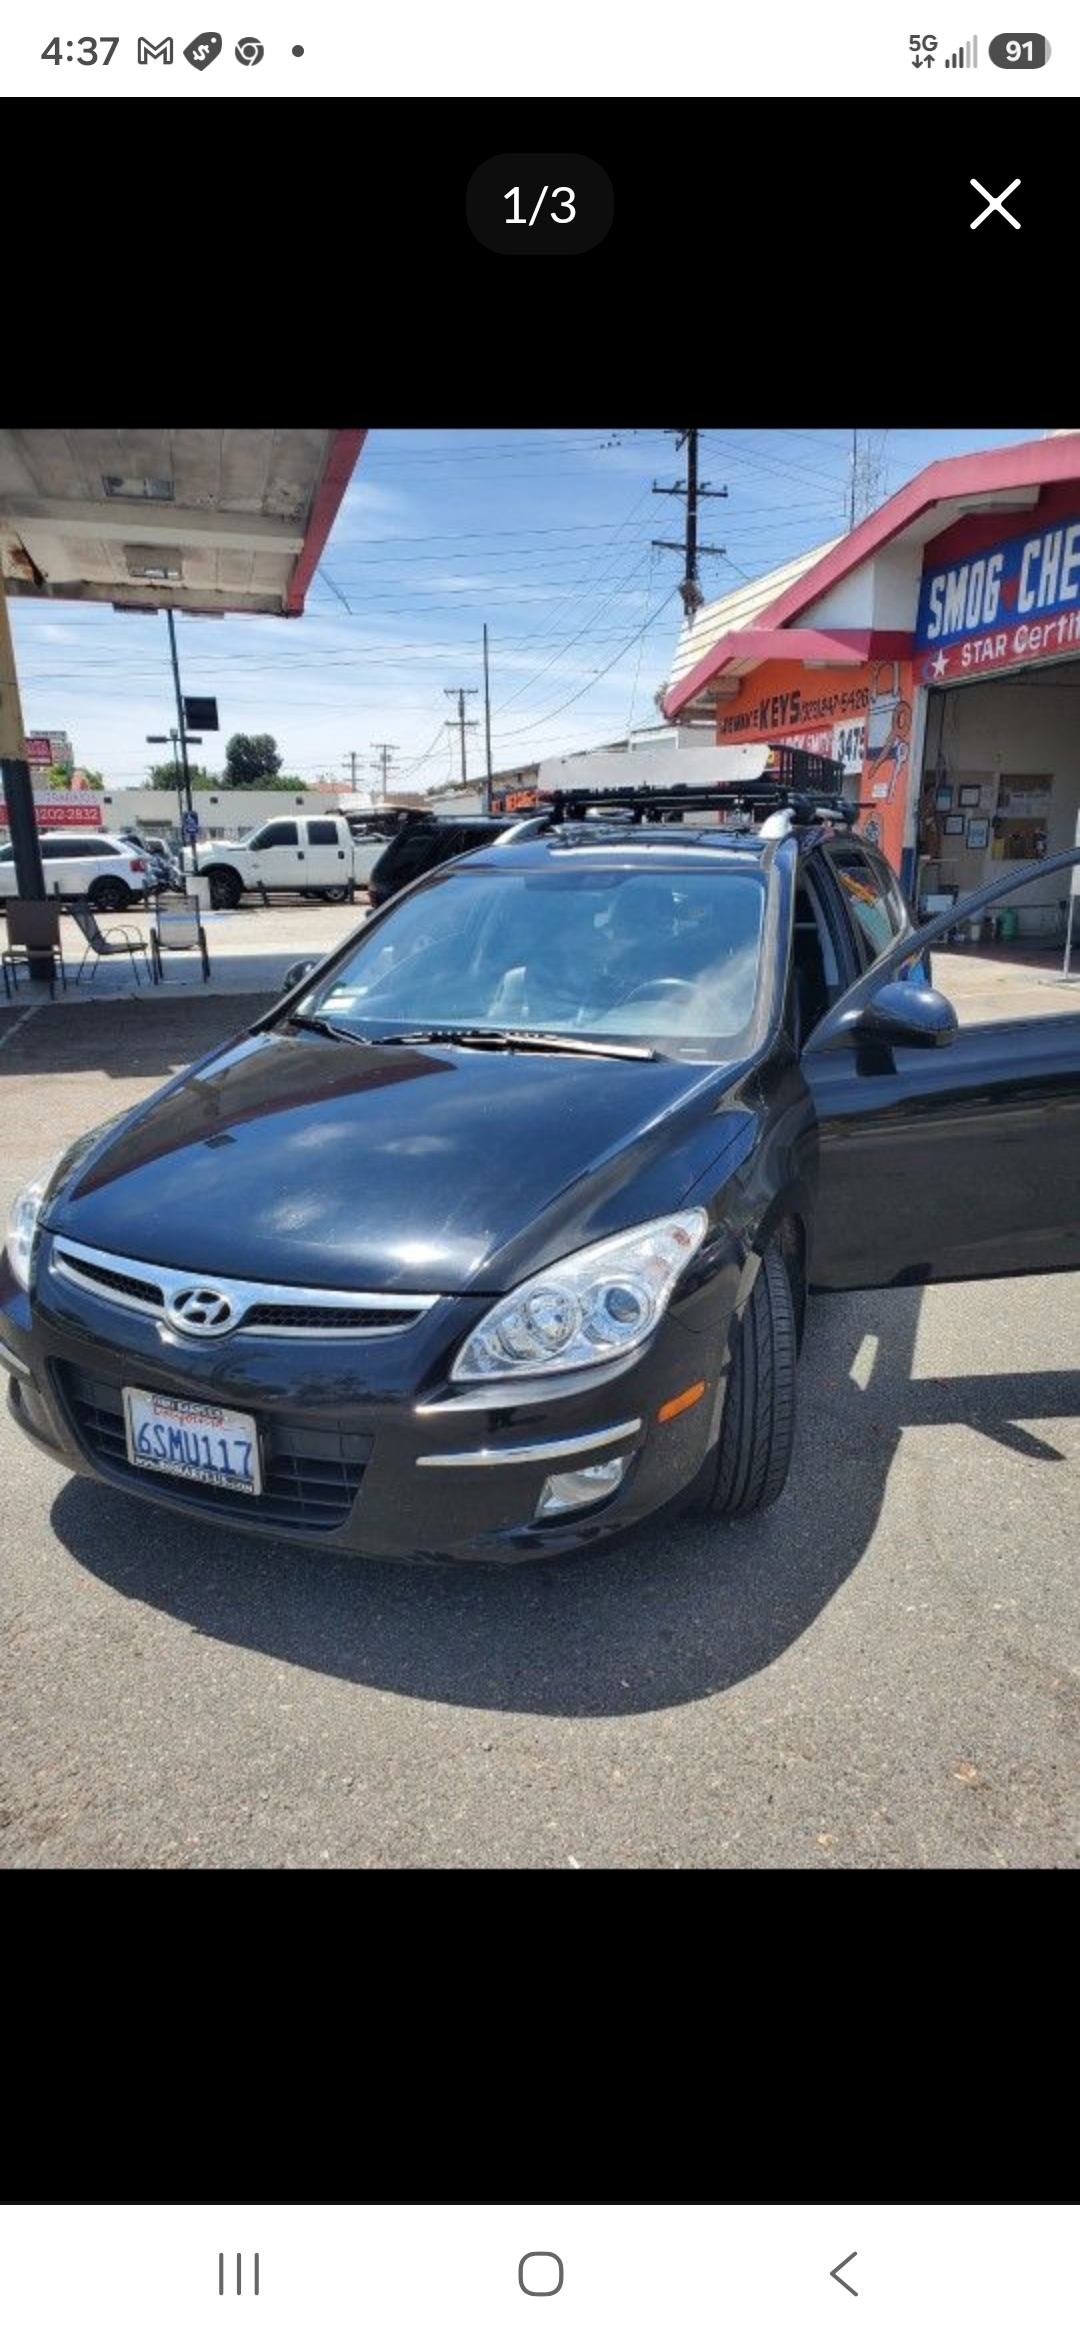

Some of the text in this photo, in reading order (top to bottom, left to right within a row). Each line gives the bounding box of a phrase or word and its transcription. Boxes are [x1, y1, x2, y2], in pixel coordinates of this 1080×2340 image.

[927, 523, 1080, 639] SMOG CHE
[961, 633, 1007, 667] STAR
[759, 690, 801, 731] KEYS
[138, 1423, 252, 1478] 6SMU117
